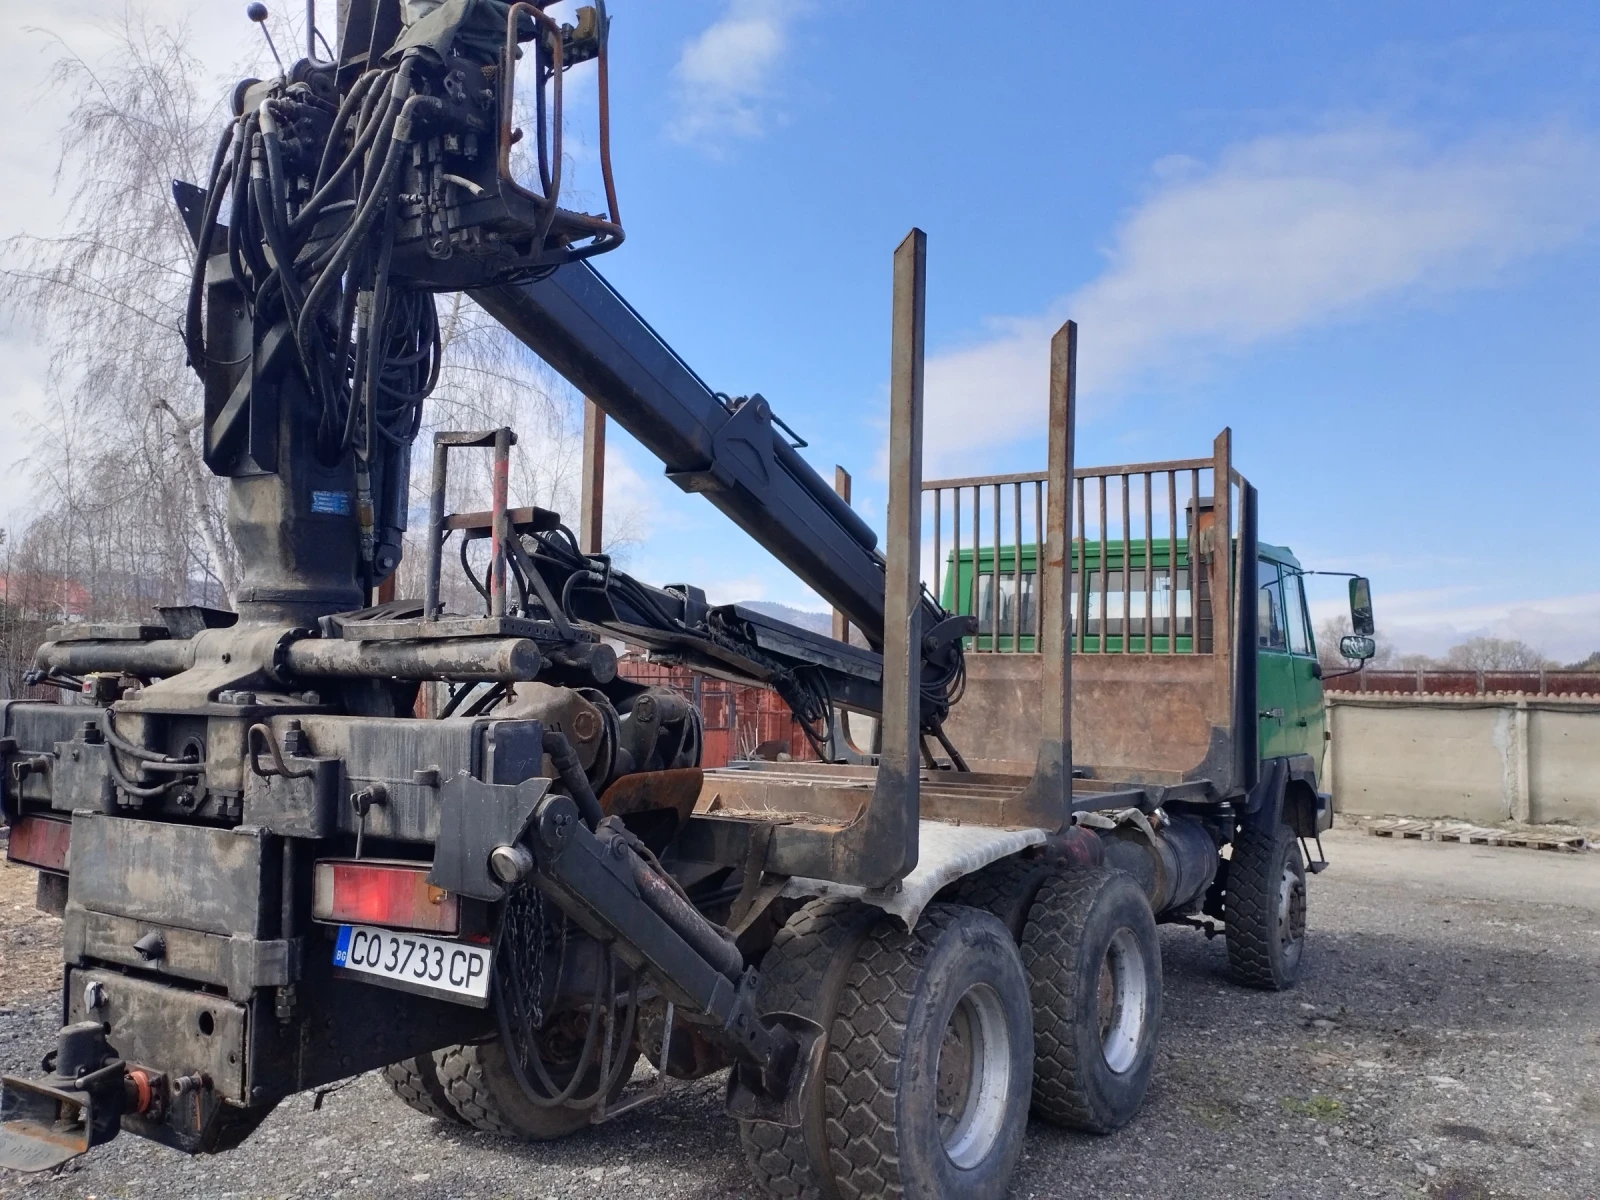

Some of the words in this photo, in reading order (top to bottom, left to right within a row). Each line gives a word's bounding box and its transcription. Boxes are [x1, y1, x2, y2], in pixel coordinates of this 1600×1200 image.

[336, 950, 346, 961] BG
[351, 931, 381, 968] CO
[384, 938, 444, 981] 3733
[449, 950, 484, 988] CP
